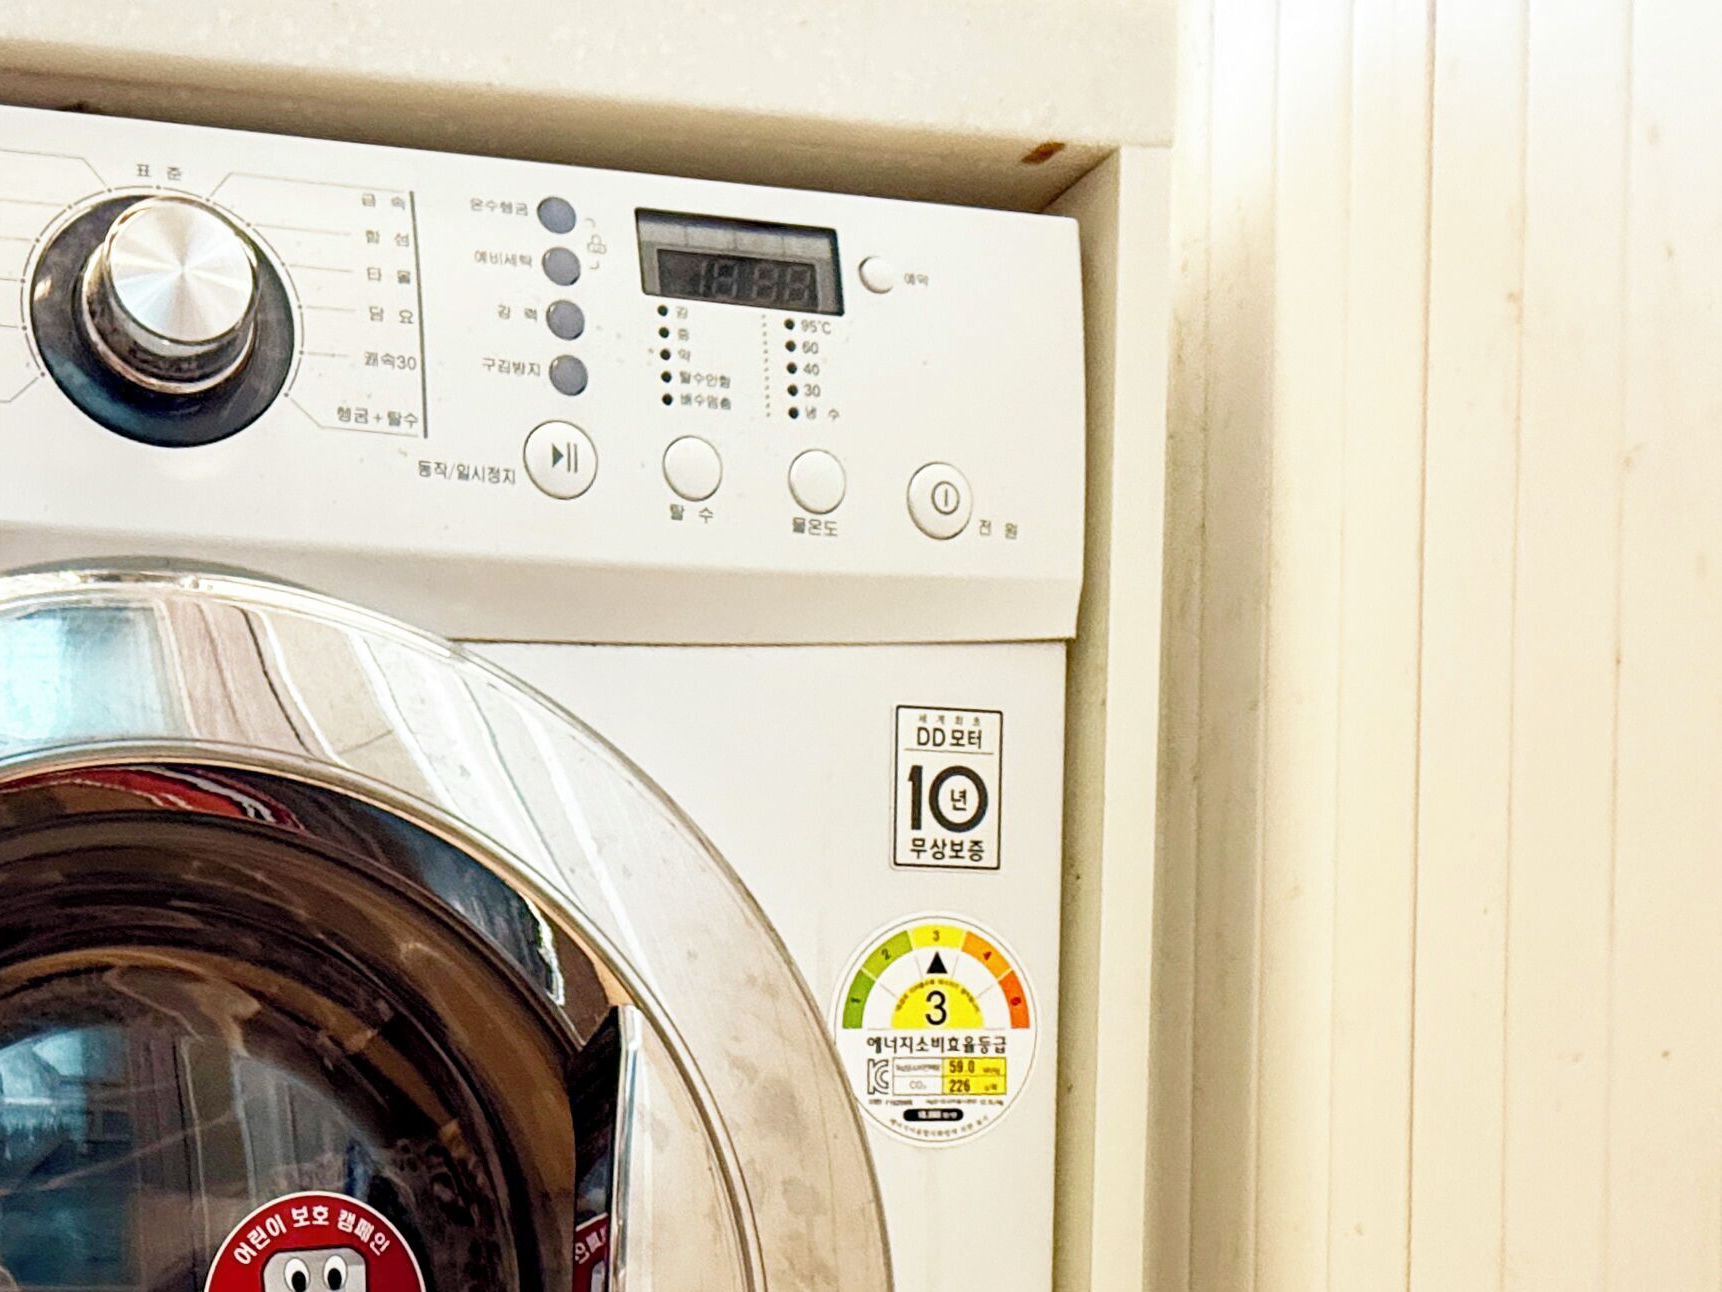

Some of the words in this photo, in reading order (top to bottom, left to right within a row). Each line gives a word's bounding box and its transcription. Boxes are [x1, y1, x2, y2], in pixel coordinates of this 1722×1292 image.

[801, 340, 820, 355] 60
[481, 357, 541, 377] 구김방지
[802, 362, 821, 377] 40
[803, 383, 822, 398] 30
[417, 459, 517, 486] 동작/일시정지
[791, 515, 840, 538] 물온도
[909, 836, 986, 863] 무상보증
[932, 929, 941, 943] 3
[924, 989, 948, 1027] 3
[865, 1035, 1008, 1055] 에너지소비효율등급
[948, 1078, 971, 1093] 226
[233, 1213, 288, 1265] 어린이
[291, 1204, 330, 1228] 보호
[337, 1208, 391, 1256] 캠페인
